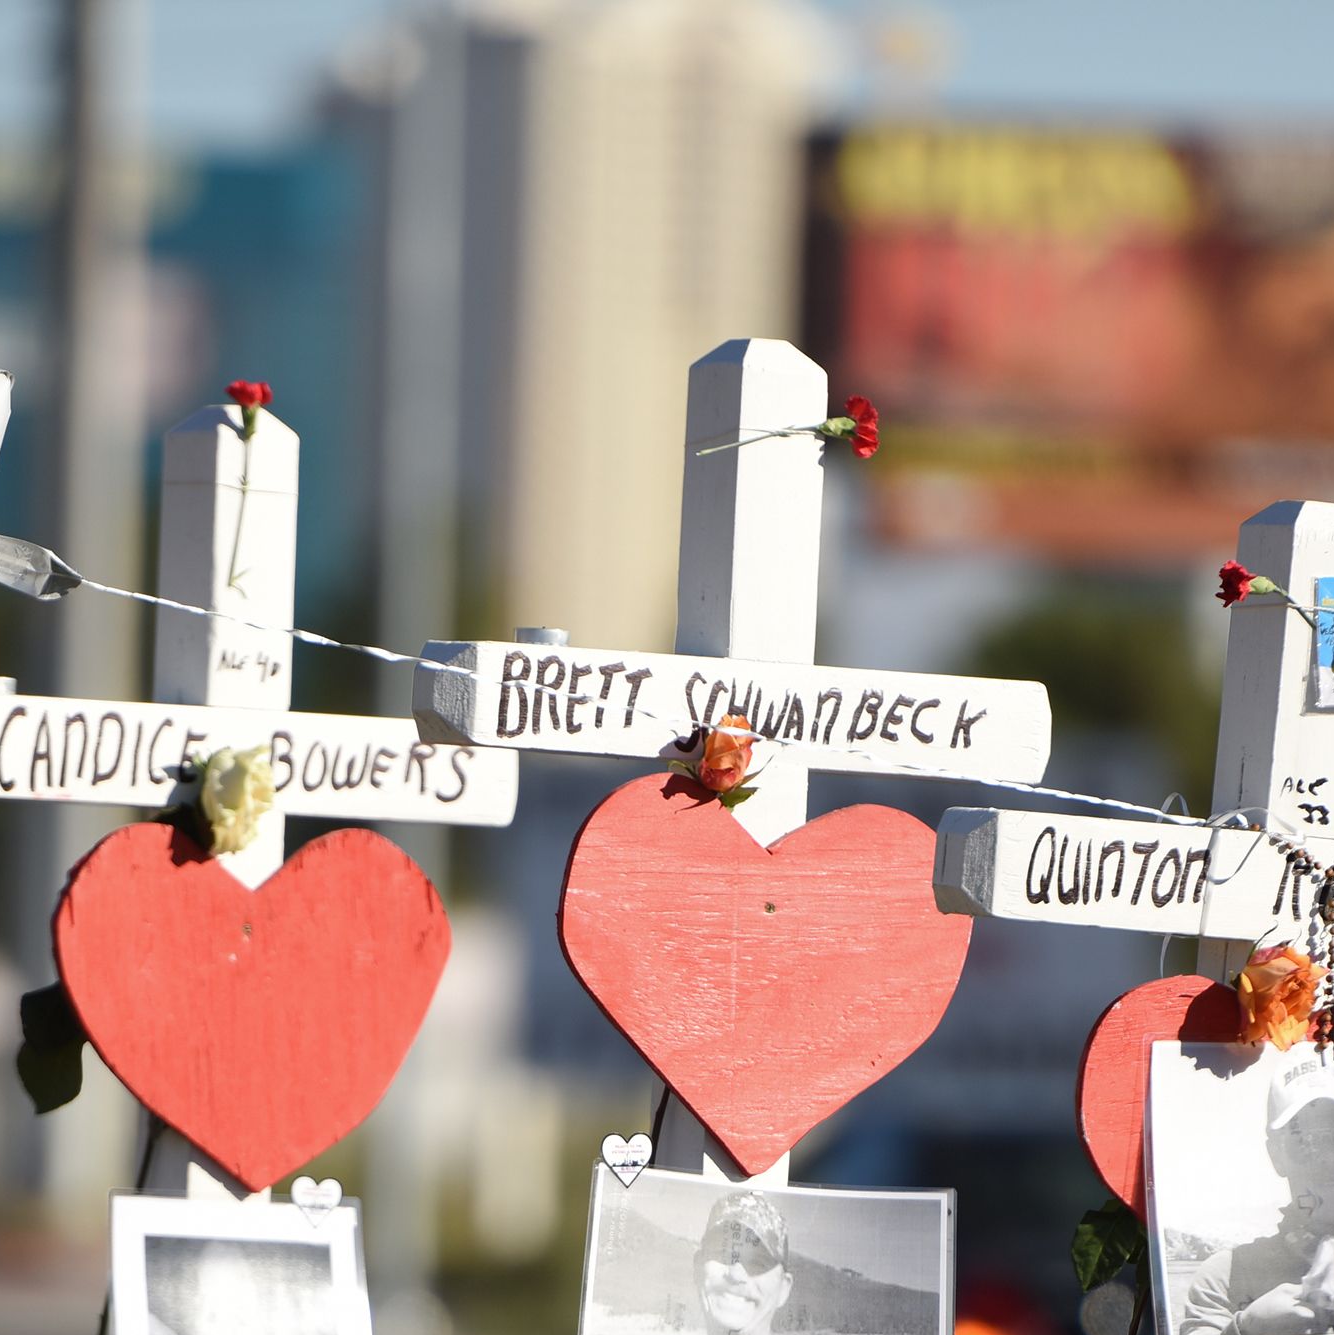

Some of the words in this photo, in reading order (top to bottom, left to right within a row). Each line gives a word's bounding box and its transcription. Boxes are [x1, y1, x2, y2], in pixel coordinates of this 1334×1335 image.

[496, 650, 653, 739] BRETT
[674, 671, 988, 753] SCHWANBECK
[270, 731, 474, 803] BOWERS
[1026, 826, 1211, 909] QUINTON
